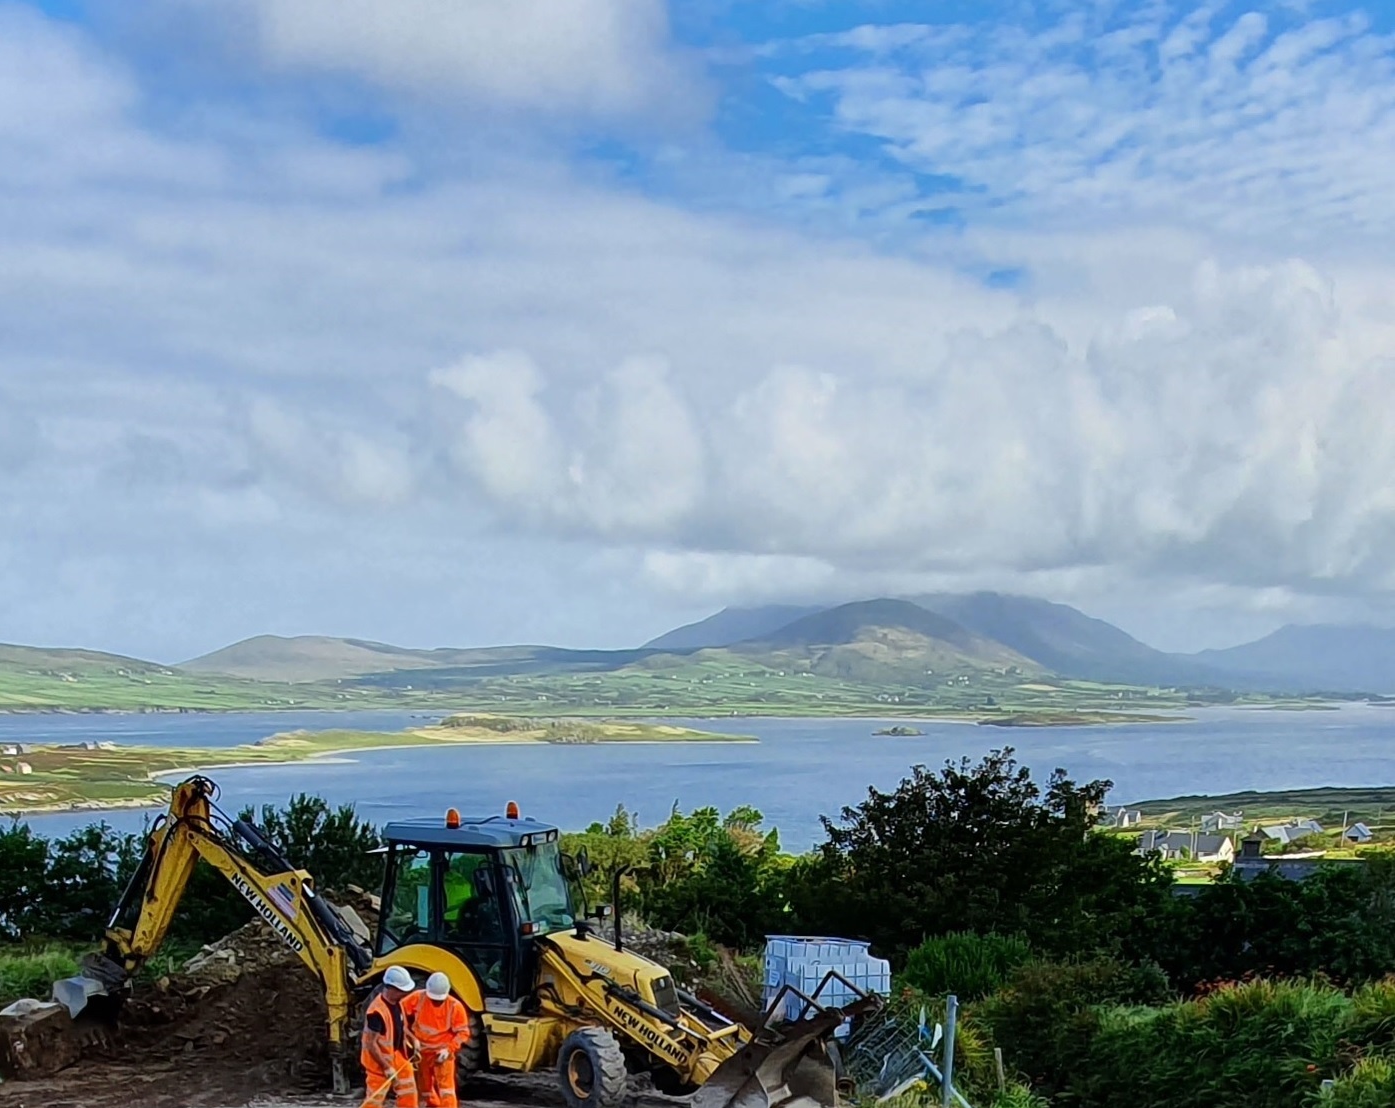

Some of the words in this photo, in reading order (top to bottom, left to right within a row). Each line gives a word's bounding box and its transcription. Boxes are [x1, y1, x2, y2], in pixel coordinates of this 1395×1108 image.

[231, 873, 258, 901] NEW
[256, 898, 303, 952] HOLLAND
[613, 1006, 638, 1030] NEW
[638, 1026, 688, 1065] HOLLAND
